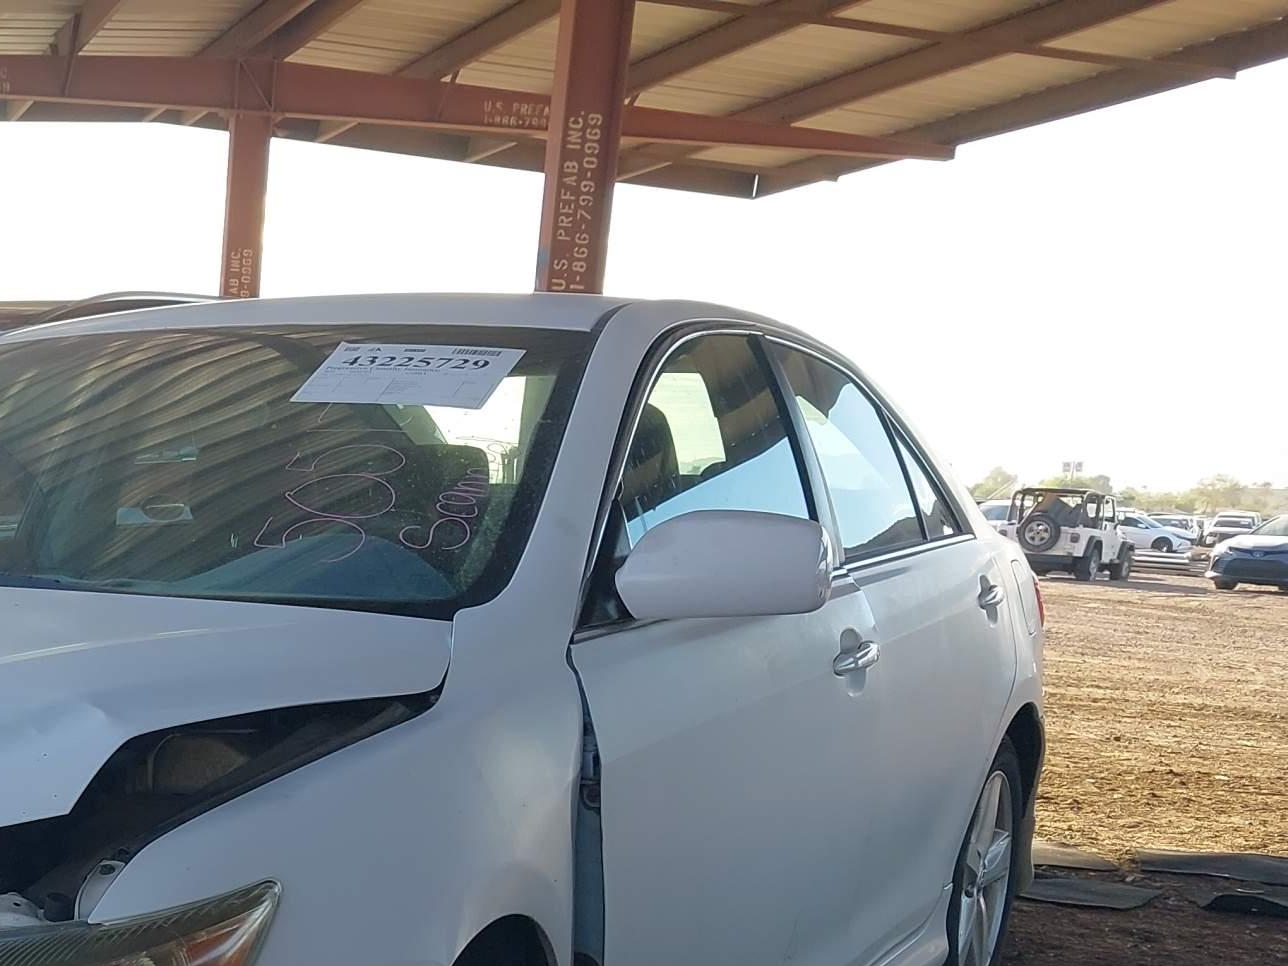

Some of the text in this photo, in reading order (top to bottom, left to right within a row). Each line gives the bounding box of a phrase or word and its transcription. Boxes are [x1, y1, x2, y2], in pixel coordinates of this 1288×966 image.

[551, 110, 585, 291] U.S. PREFAB INC.
[569, 112, 603, 290] 1-866-799-0969
[342, 355, 490, 370] 43225729
